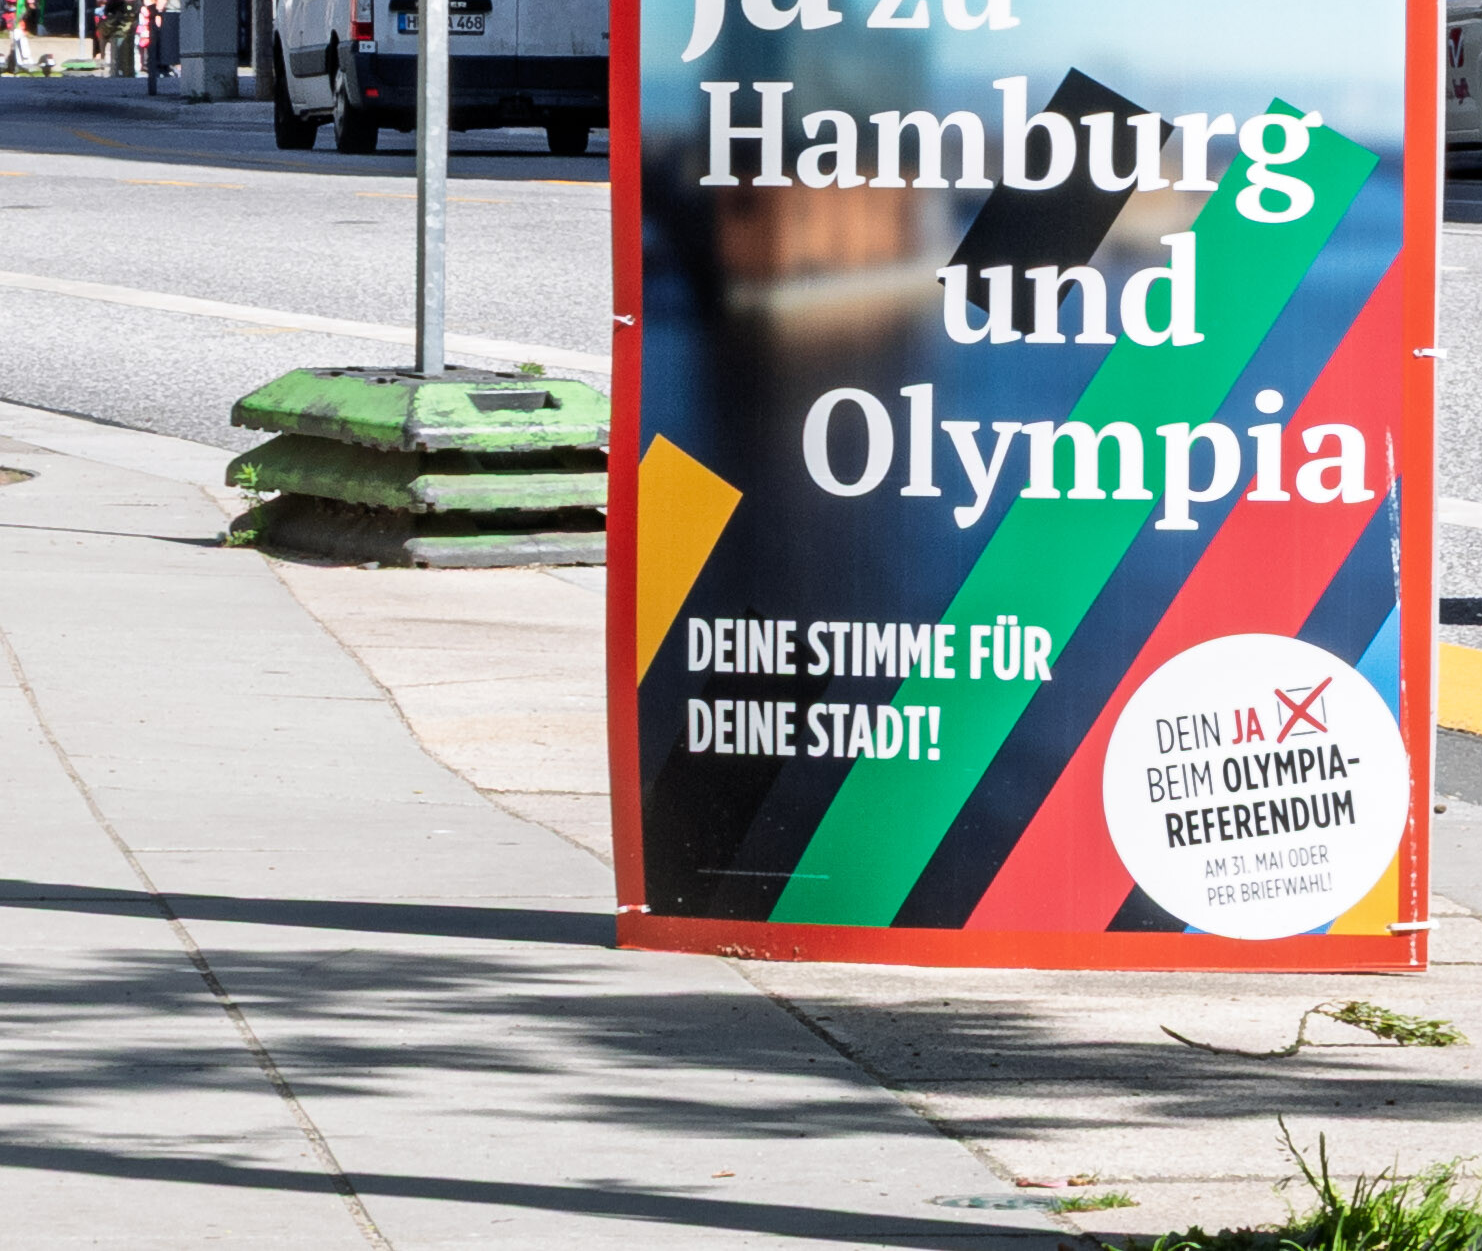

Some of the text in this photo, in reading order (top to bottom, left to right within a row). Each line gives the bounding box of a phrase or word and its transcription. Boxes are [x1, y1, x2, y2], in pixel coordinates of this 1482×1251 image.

[456, 15, 483, 31] 468
[699, 76, 1324, 224] Hamburg
[935, 230, 1205, 348] und
[801, 383, 1376, 532] Olympia
[688, 615, 1053, 681] DEINE STIMME FÜR
[688, 698, 942, 761] DEINE STADT!
[1156, 707, 1266, 754] DEIN JA
[1146, 743, 1361, 803] BEIM OLYMPIA-
[1165, 789, 1357, 849] REFERENDUM
[1204, 844, 1330, 880] AM 31. MAI ODER
[1207, 871, 1334, 907] PER BRIEFWAHL!
